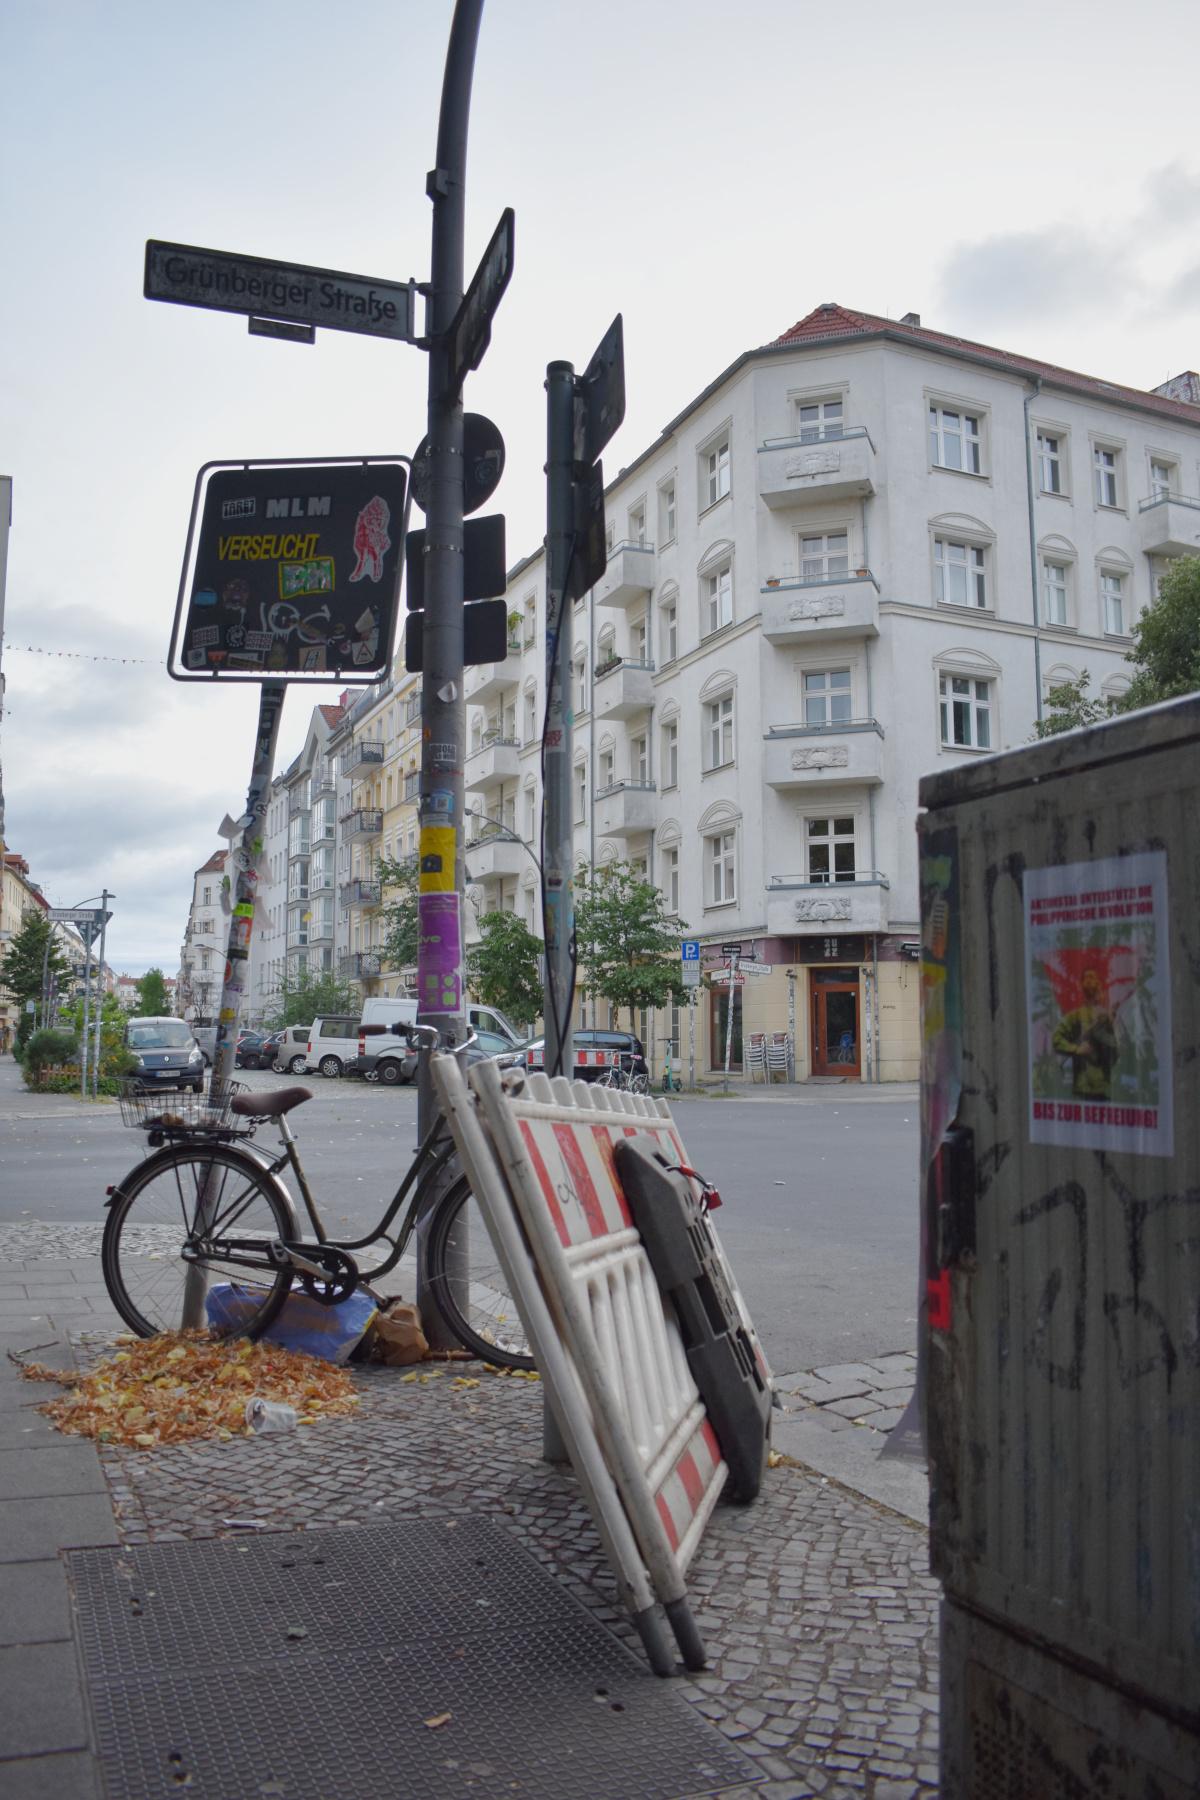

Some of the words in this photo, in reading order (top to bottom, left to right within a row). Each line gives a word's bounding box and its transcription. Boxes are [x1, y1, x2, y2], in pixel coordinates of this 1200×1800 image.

[164, 257, 312, 307] Grünberger
[320, 283, 397, 323] Straße
[266, 496, 331, 519] MLM
[218, 533, 320, 561] VERSEUCHT
[1098, 901, 1153, 919] REVOLUTION
[685, 943, 696, 959] P
[1033, 1101, 1055, 1120] BIS
[1057, 1103, 1082, 1123] ZUR
[1083, 1104, 1158, 1130] BEFREIUNG!
